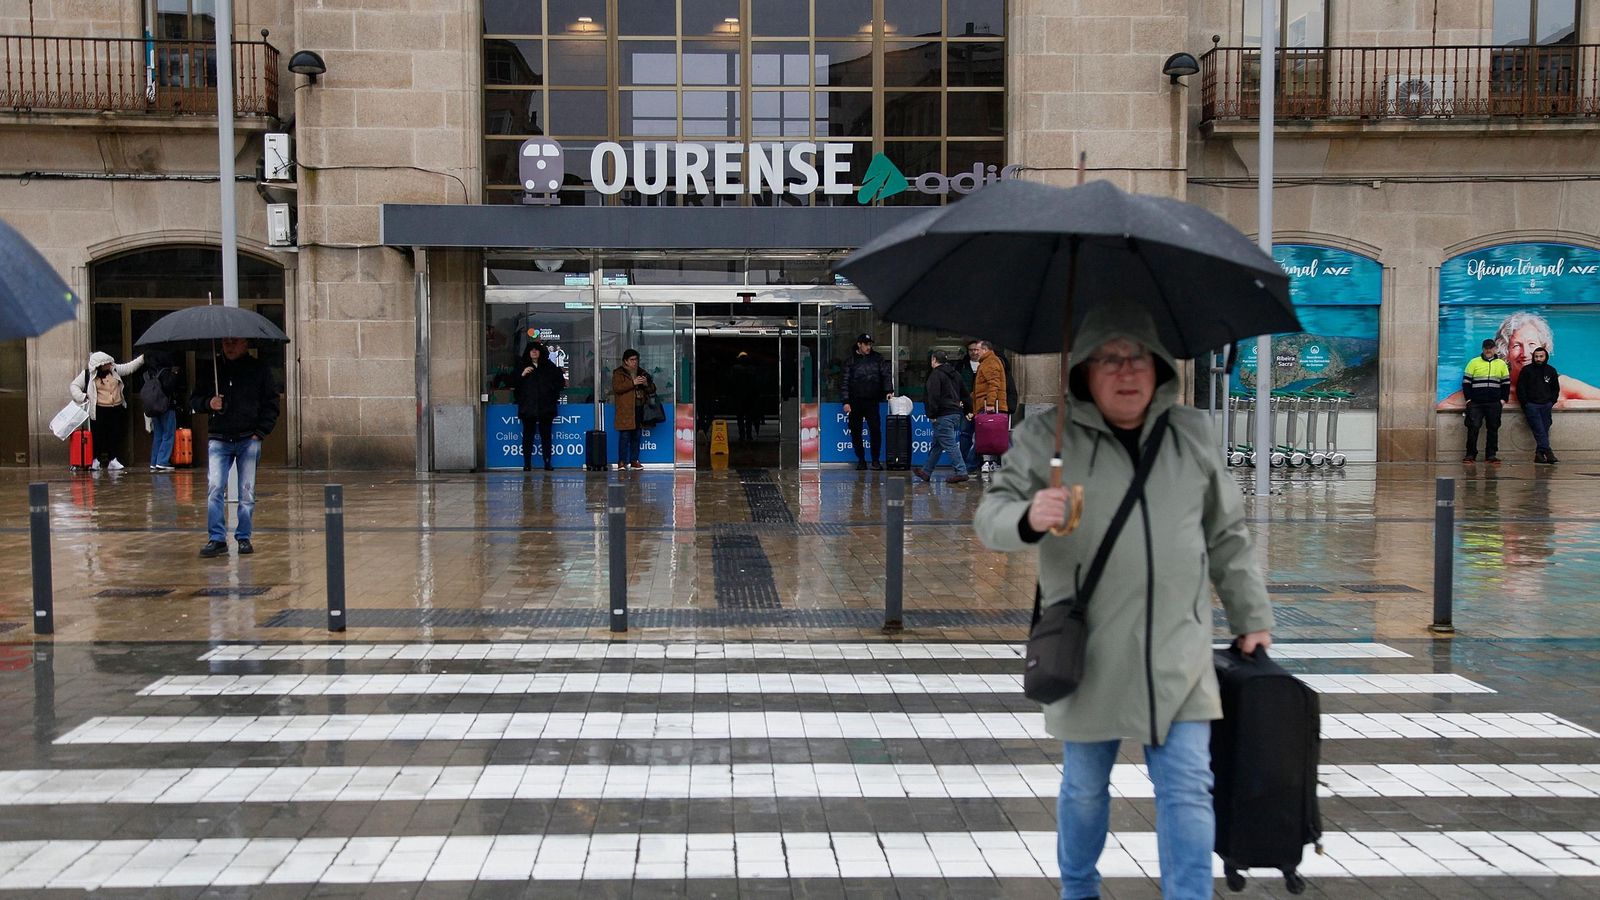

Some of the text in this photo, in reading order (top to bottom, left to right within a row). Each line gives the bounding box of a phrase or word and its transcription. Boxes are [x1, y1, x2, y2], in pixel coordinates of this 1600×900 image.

[590, 142, 853, 195] OURENSE
[1322, 267, 1353, 276] AVE
[1467, 257, 1600, 280] Oficina Termal AVE
[502, 415, 581, 425] VITENT
[496, 431, 519, 441] Calle
[556, 431, 582, 440] Risco,
[567, 443, 584, 455] 00
